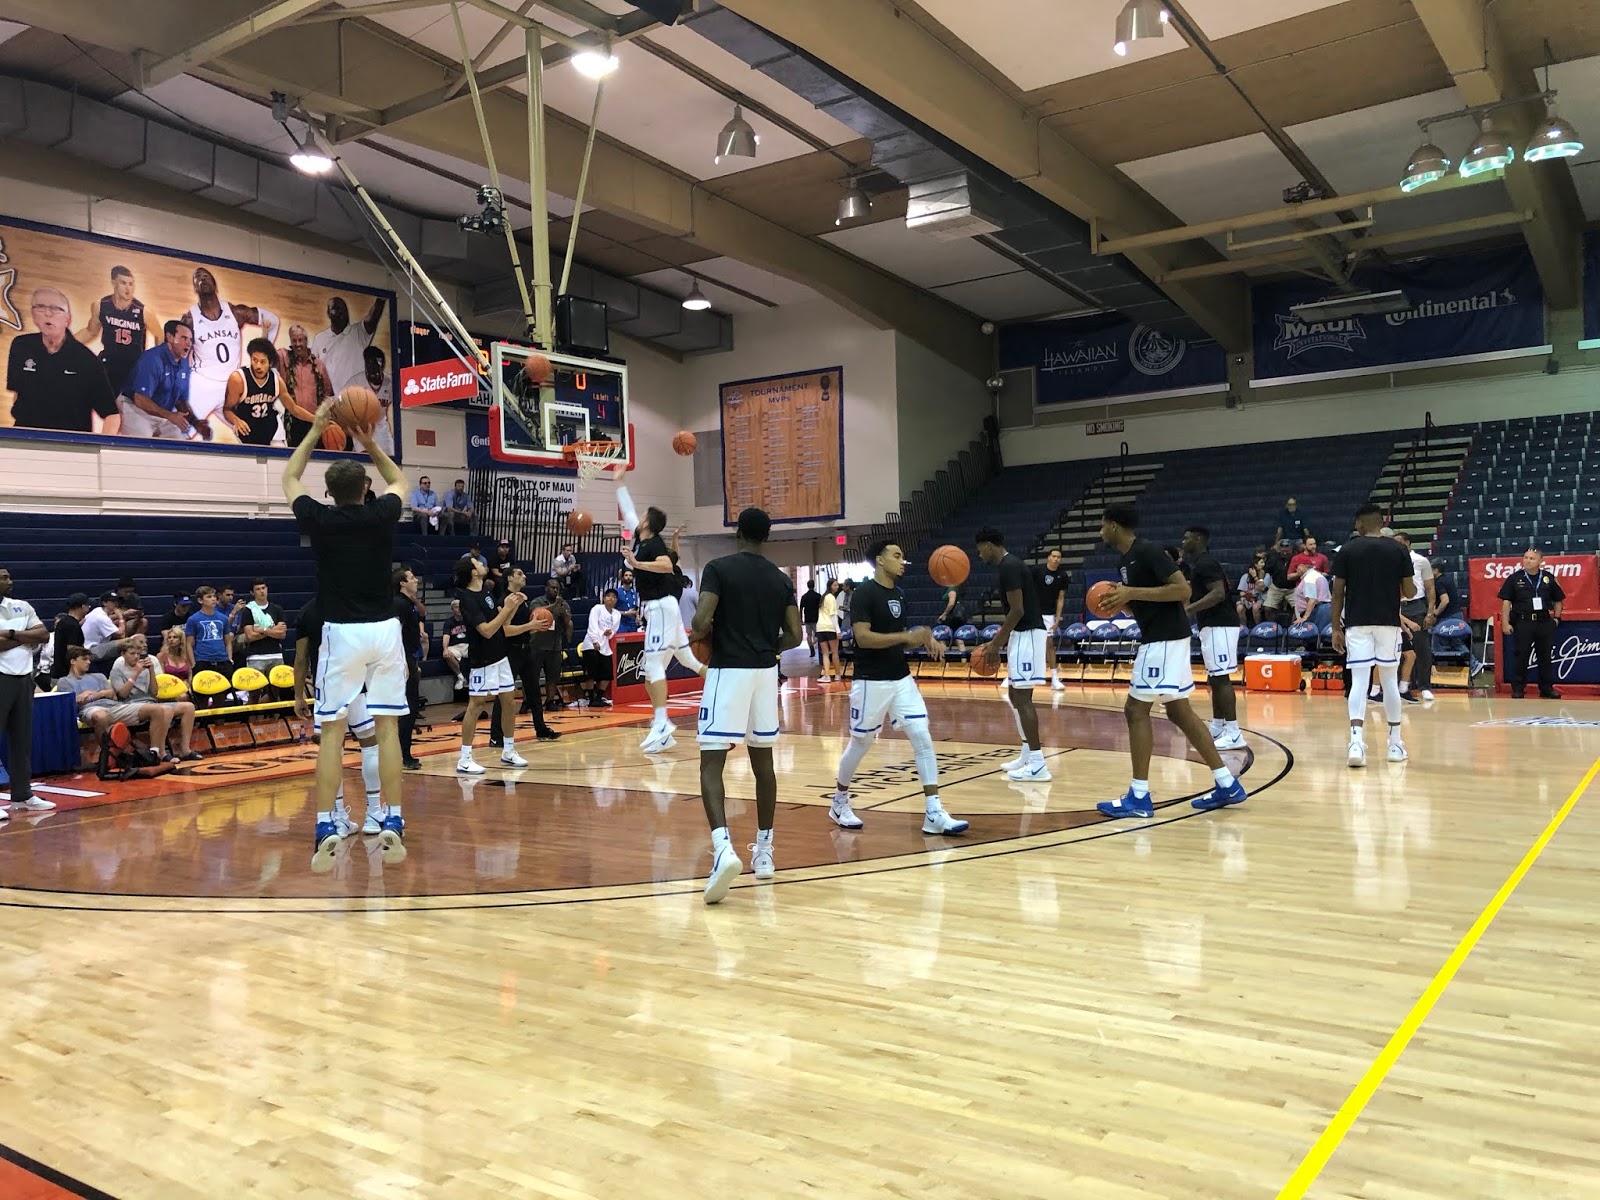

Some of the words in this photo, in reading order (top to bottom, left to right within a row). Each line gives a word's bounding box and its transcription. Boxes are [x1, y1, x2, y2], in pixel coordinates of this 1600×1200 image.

[105, 315, 141, 331] VIRGINIA
[115, 328, 133, 346] 15
[198, 329, 239, 344] KANSAS
[216, 342, 230, 364] 0
[1043, 341, 1118, 372] HAWAIIAN
[750, 383, 809, 397] TOURNAMENT
[251, 402, 269, 418] 32
[1086, 423, 1095, 435] NO
[1096, 420, 1124, 433] SMOKING
[539, 480, 551, 491] OF
[552, 482, 575, 492] MAUI
[1022, 662, 1032, 672] D
[1148, 667, 1160, 678] D
[1261, 664, 1273, 678] G
